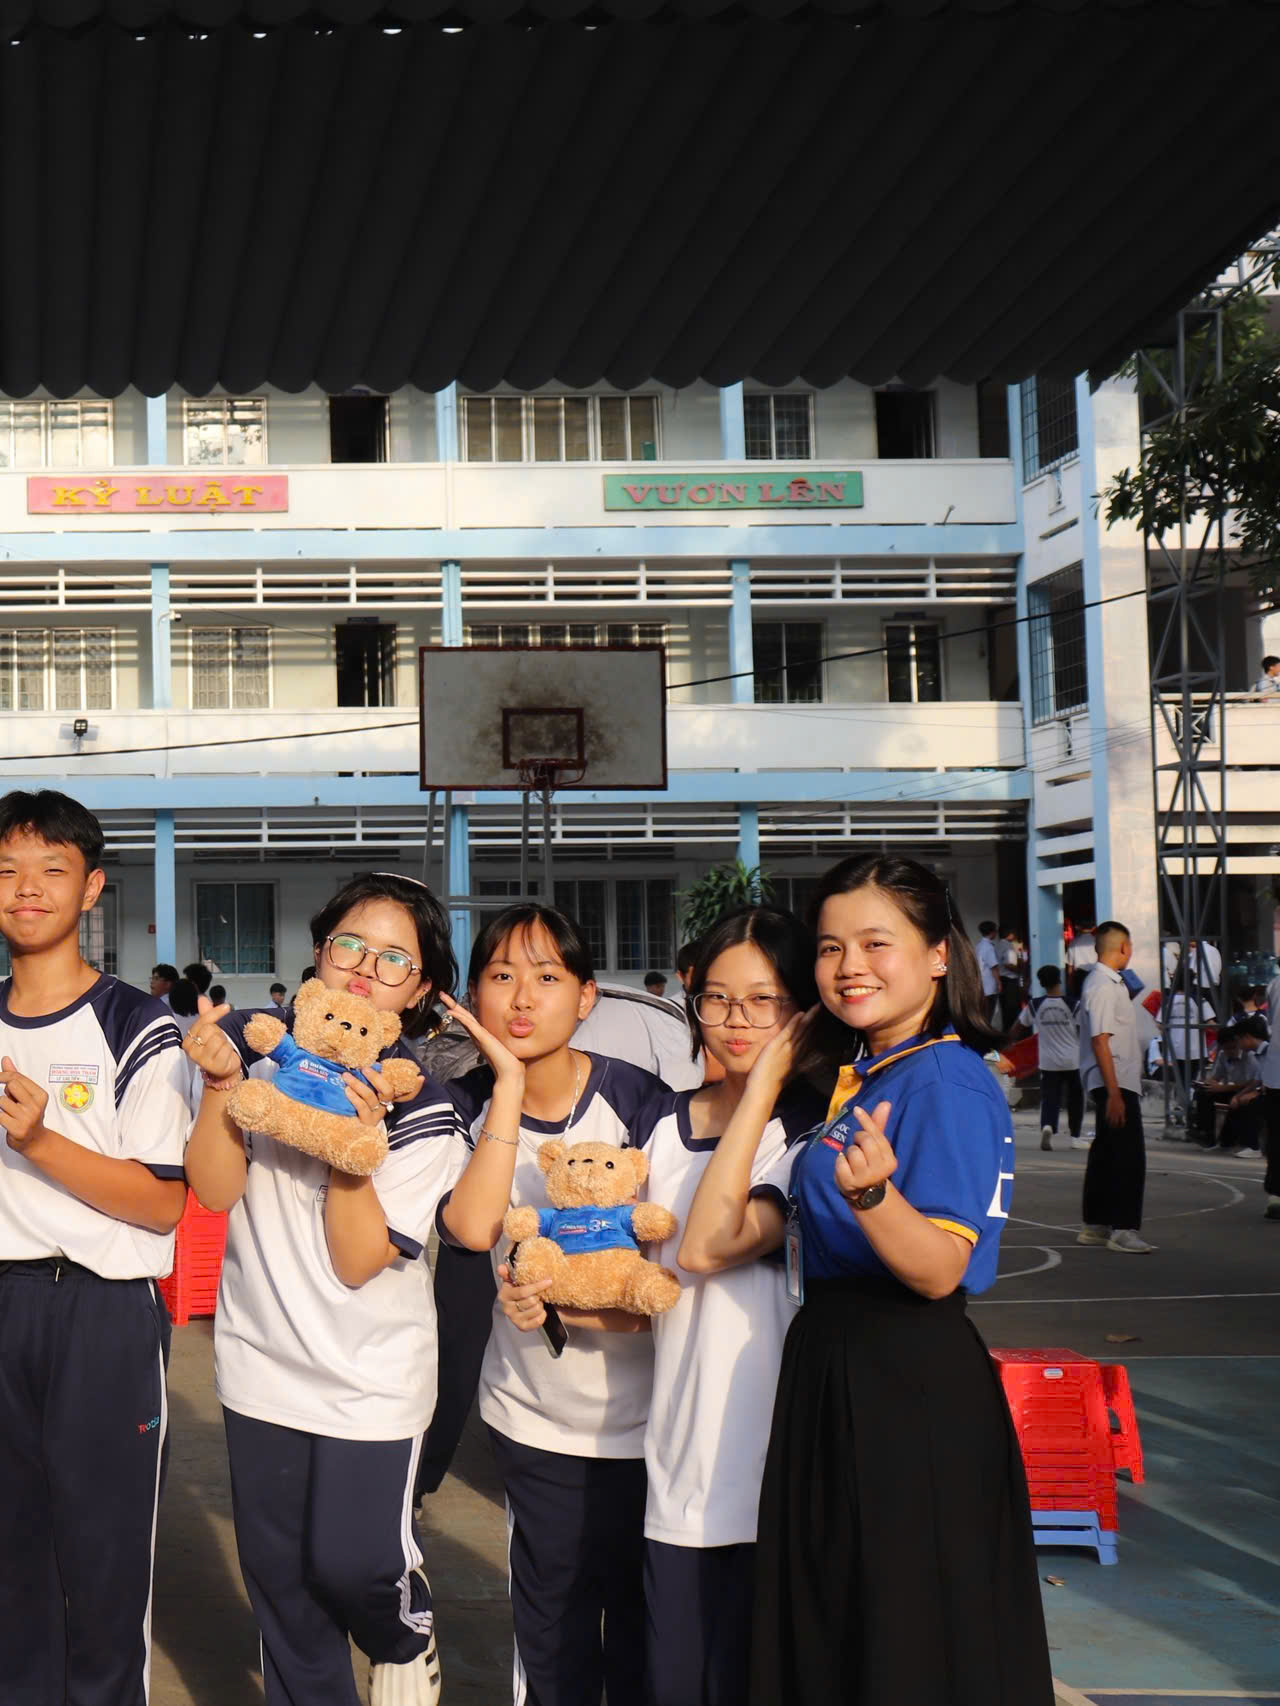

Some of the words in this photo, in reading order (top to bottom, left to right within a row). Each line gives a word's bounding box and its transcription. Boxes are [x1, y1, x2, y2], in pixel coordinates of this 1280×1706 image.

[52, 480, 120, 506] KỶ
[135, 481, 264, 513] LUẬT
[759, 477, 846, 503] LÊN
